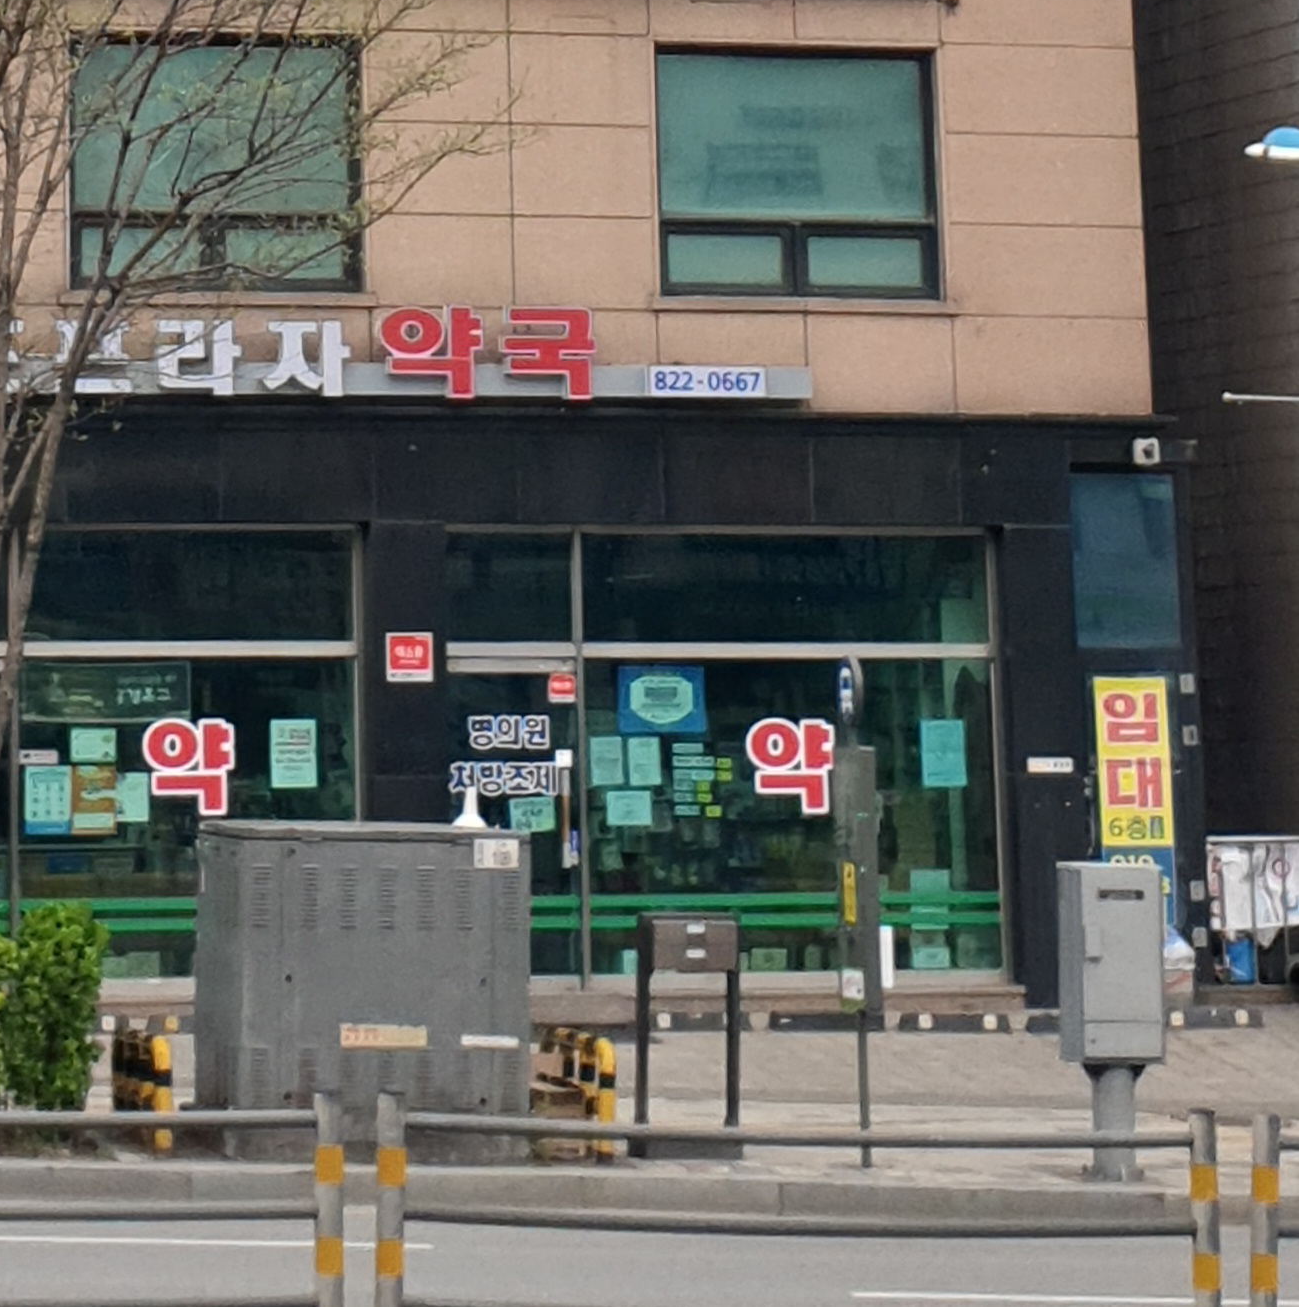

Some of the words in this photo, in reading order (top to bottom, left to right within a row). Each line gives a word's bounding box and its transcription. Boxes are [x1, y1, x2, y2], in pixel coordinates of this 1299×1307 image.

[379, 304, 596, 400] 약국
[653, 370, 761, 393] 822-0667
[141, 717, 236, 816] 약
[745, 717, 835, 816] 약
[1102, 692, 1163, 809] 임대
